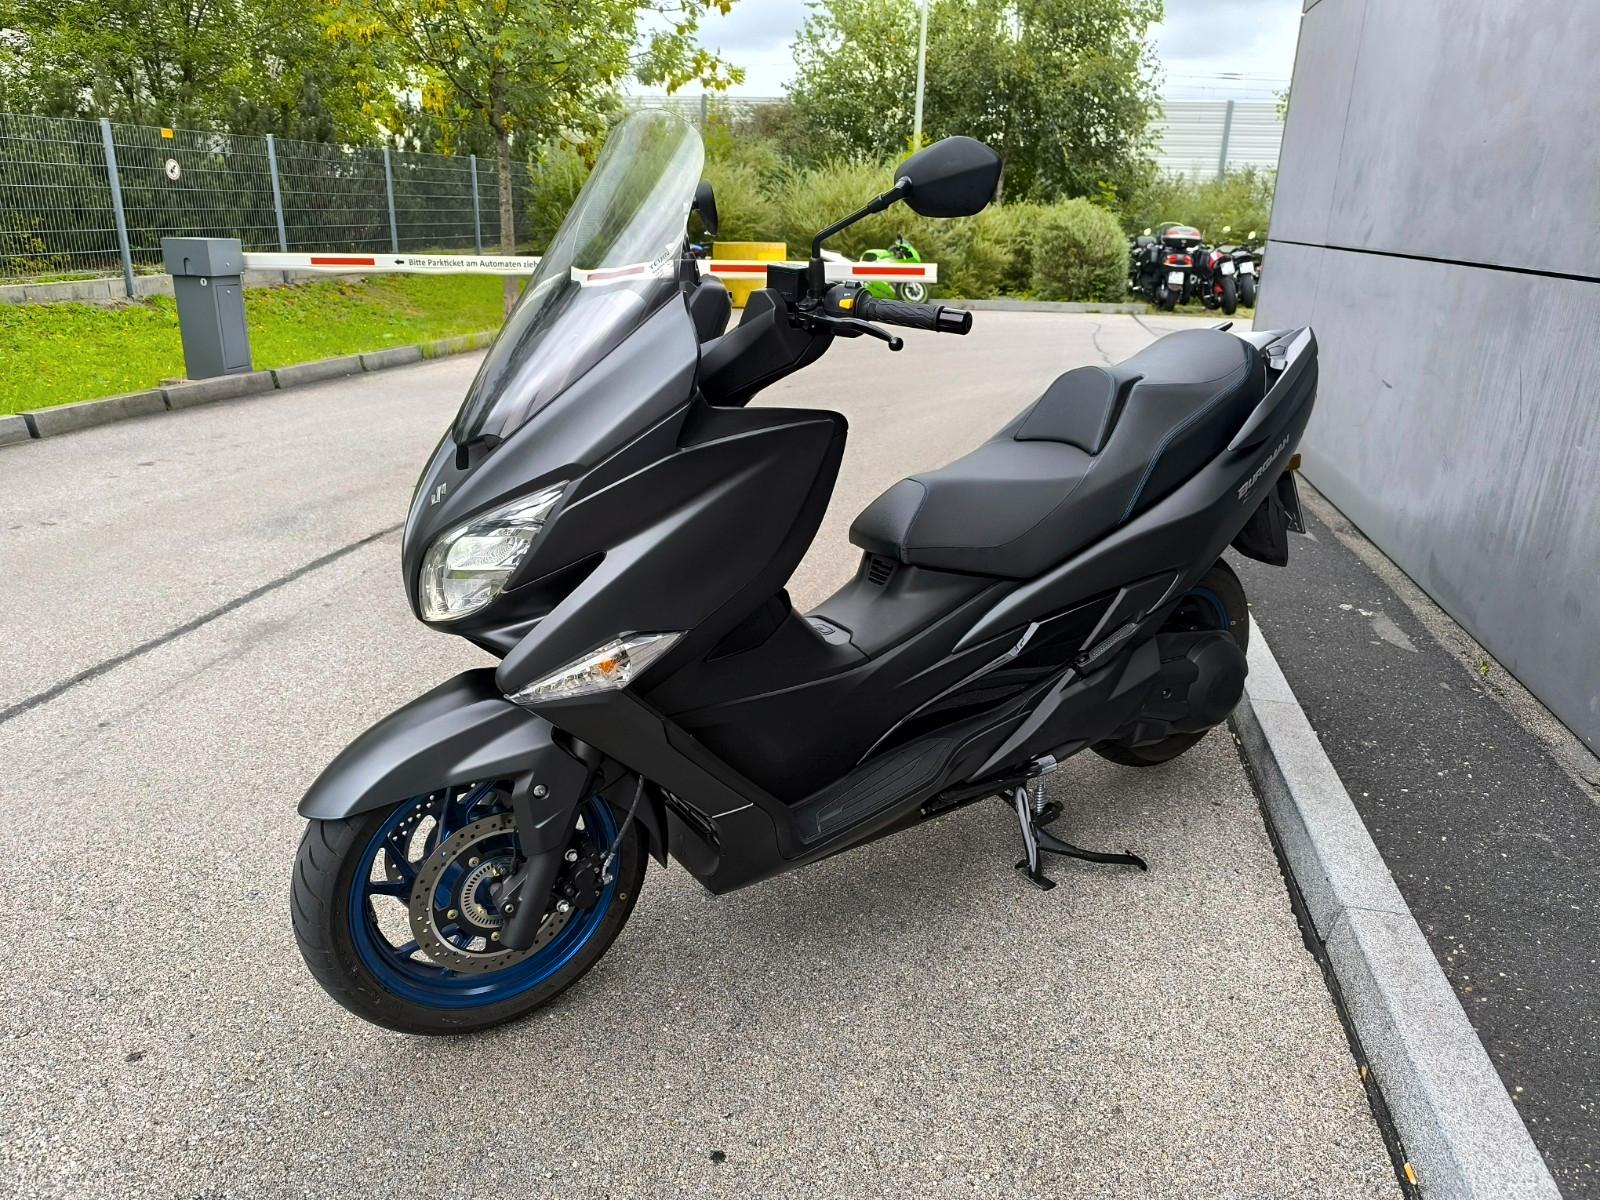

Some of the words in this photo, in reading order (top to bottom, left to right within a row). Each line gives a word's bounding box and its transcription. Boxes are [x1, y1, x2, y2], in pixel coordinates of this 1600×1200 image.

[408, 258, 426, 267] Bitte
[428, 258, 464, 268] Parkticket
[479, 260, 521, 269] Automaten
[1238, 434, 1289, 499] BURGMAN
